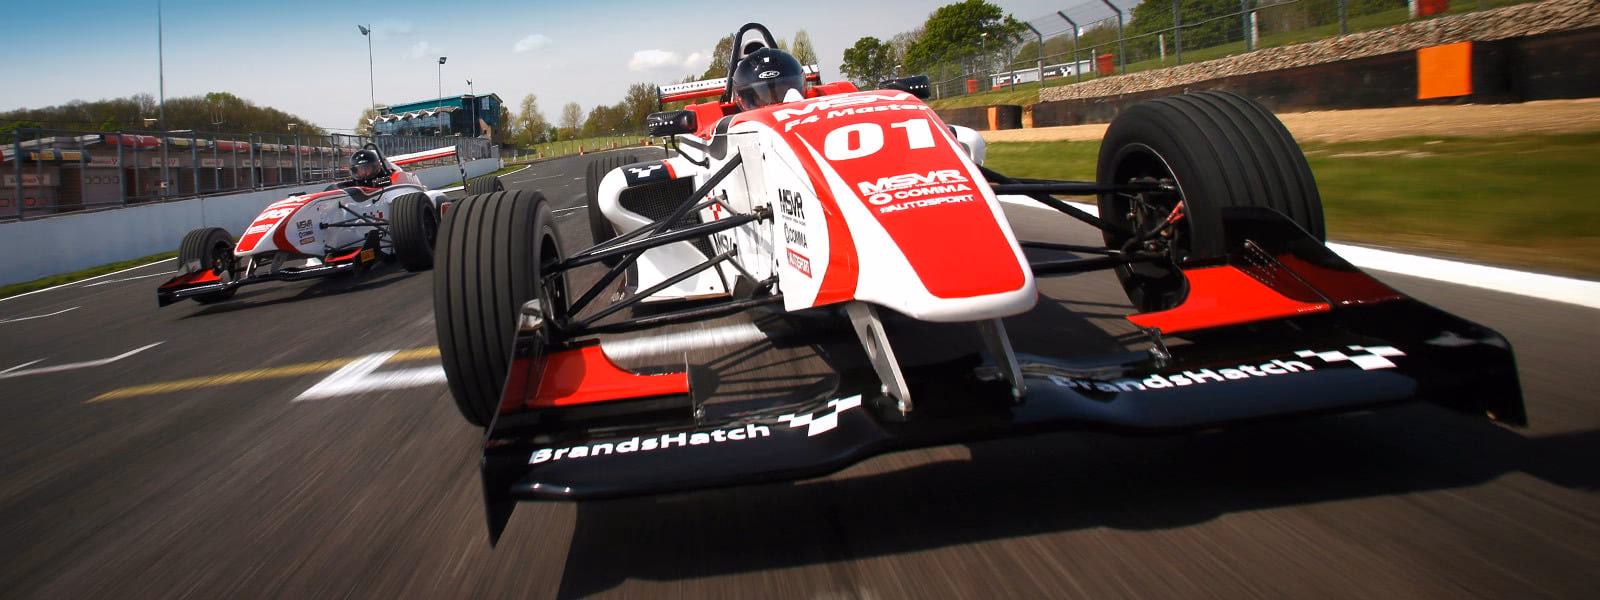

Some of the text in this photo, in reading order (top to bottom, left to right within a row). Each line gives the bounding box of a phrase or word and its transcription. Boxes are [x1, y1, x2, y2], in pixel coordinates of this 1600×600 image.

[784, 114, 821, 132] F4
[824, 118, 936, 161] 01
[857, 169, 969, 196] MSVR
[894, 184, 972, 199] COMMA
[778, 188, 805, 219] MSVR
[528, 424, 770, 465] BrandsHatch
